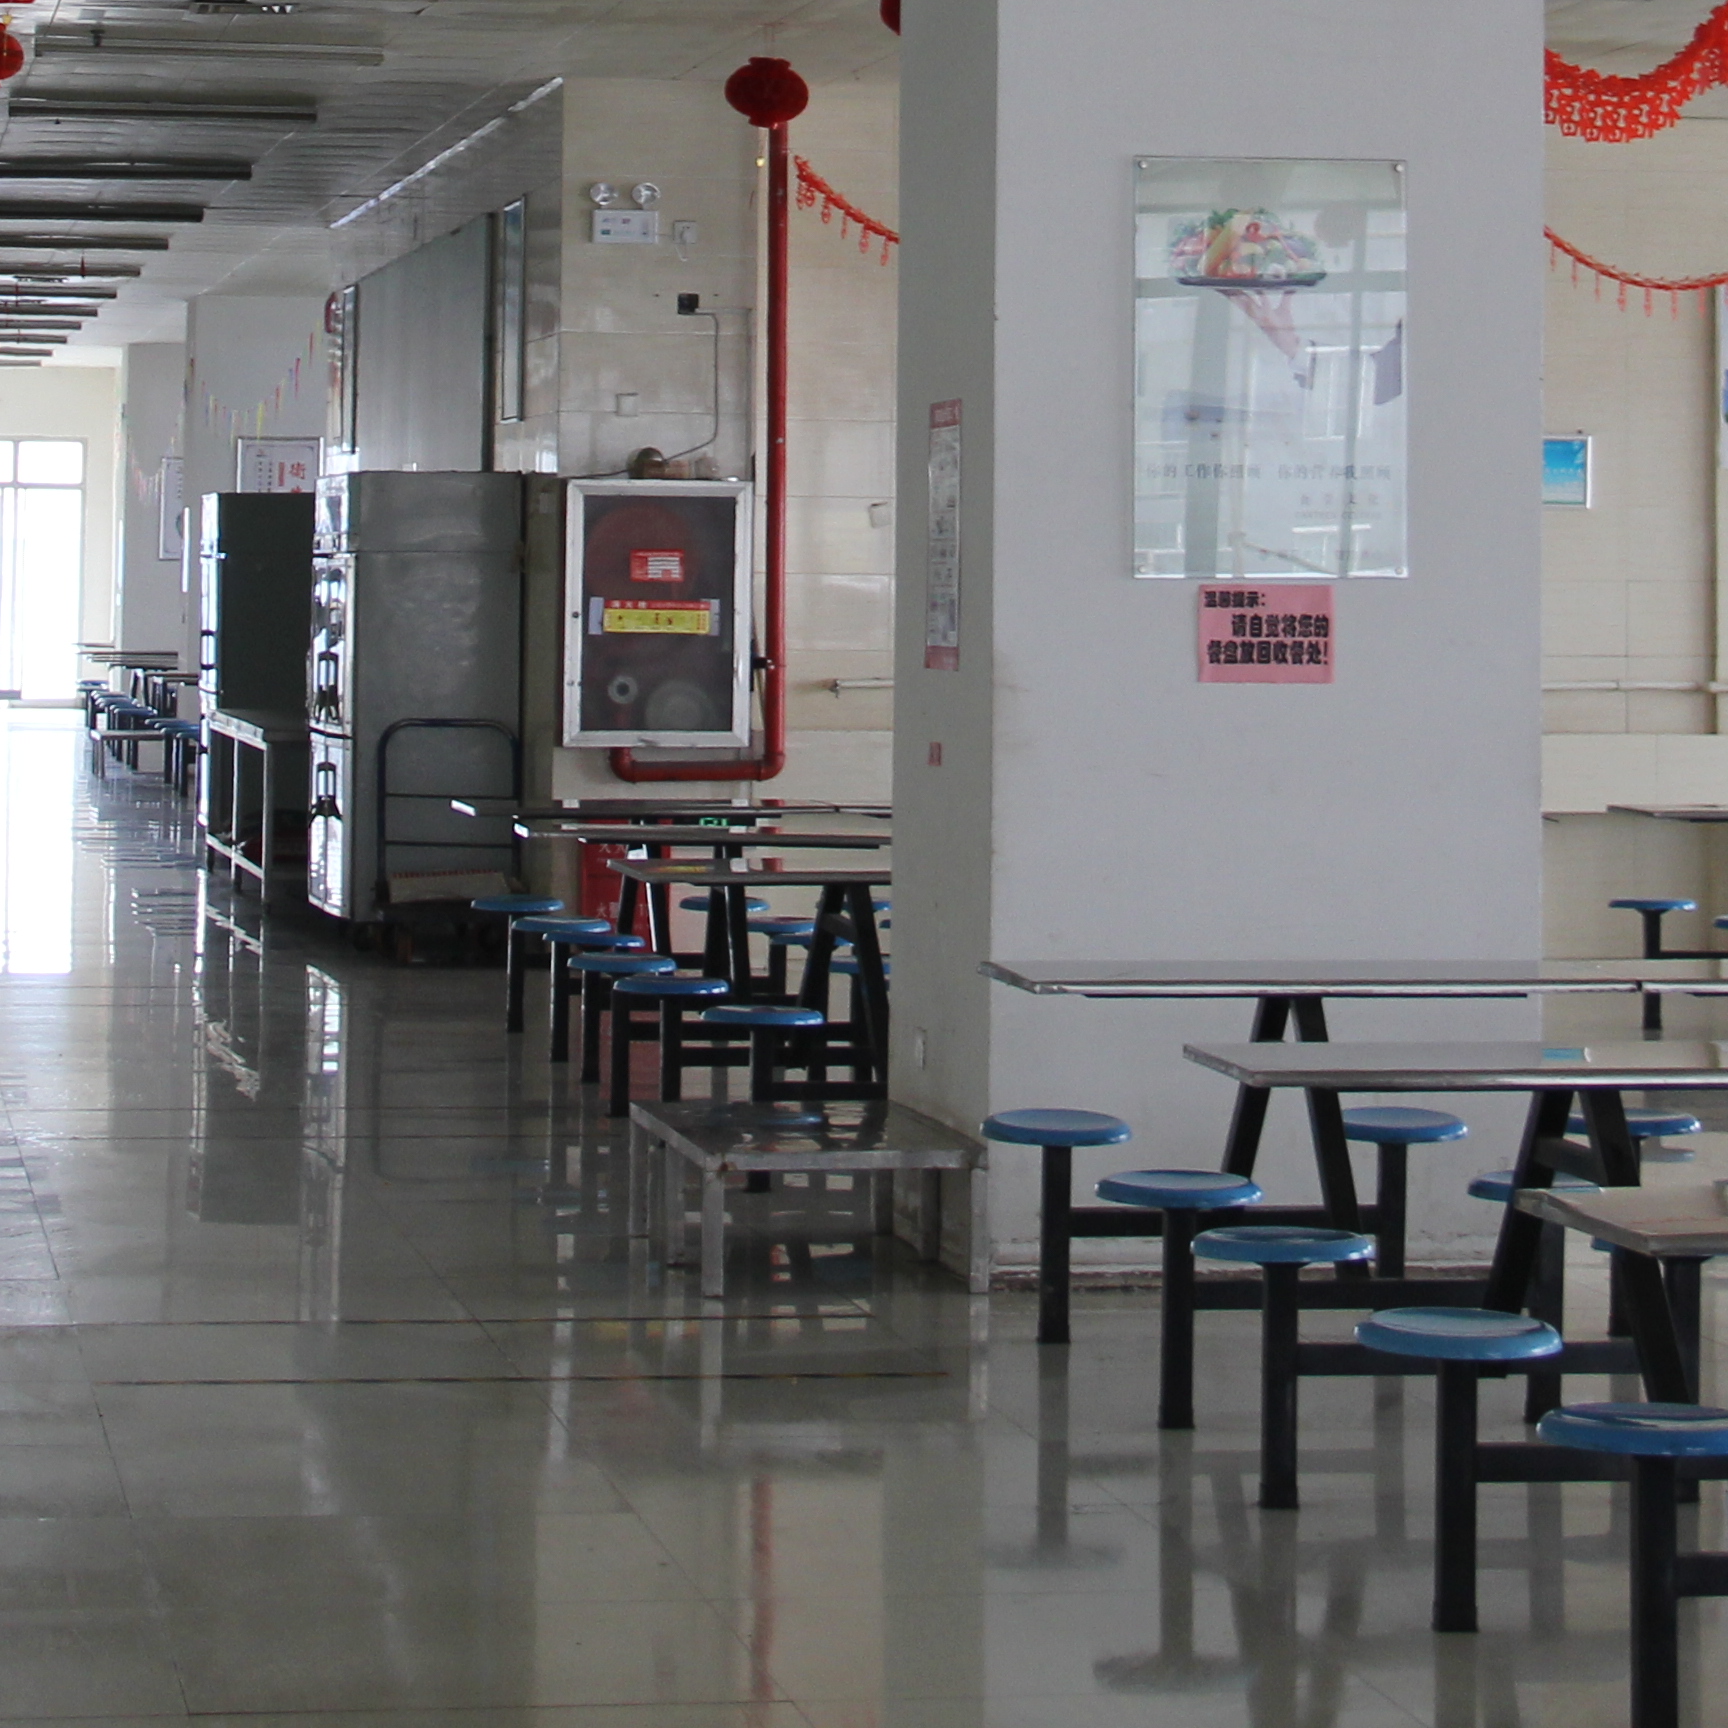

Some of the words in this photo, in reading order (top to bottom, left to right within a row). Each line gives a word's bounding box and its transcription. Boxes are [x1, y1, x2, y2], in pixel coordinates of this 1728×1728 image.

[1231, 613, 1329, 638] 请自觉将您的
